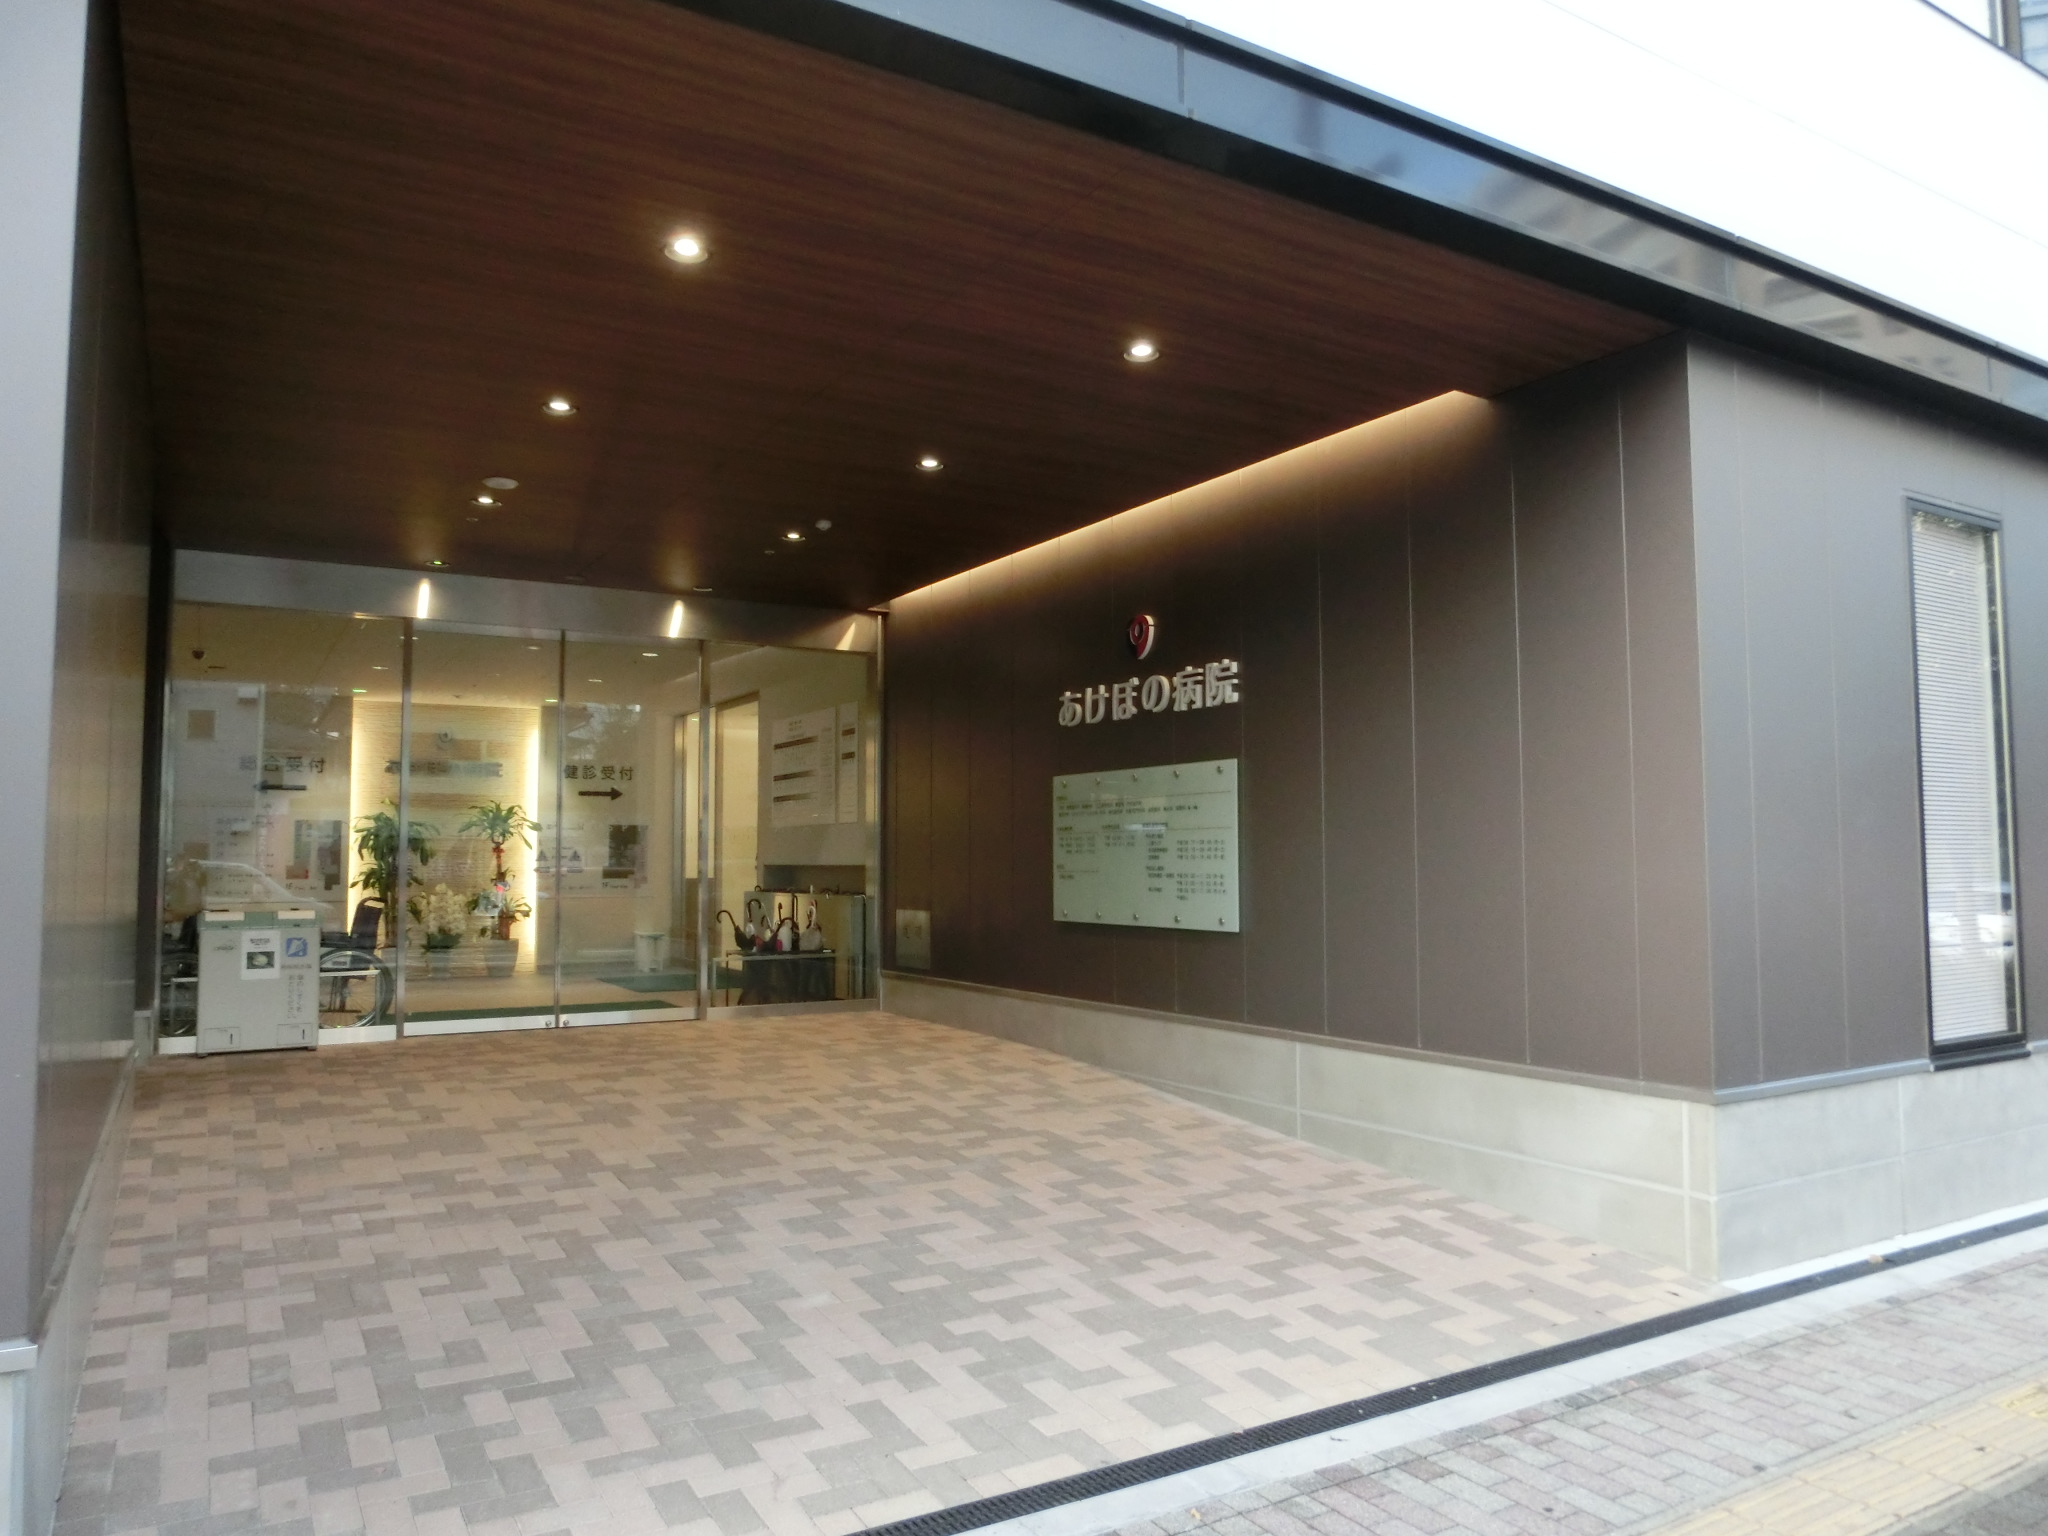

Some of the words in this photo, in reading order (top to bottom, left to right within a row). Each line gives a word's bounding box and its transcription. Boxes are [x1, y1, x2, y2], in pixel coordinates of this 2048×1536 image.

[1058, 658, 1240, 727] あけぼの病院
[564, 764, 634, 781] 健診受付
